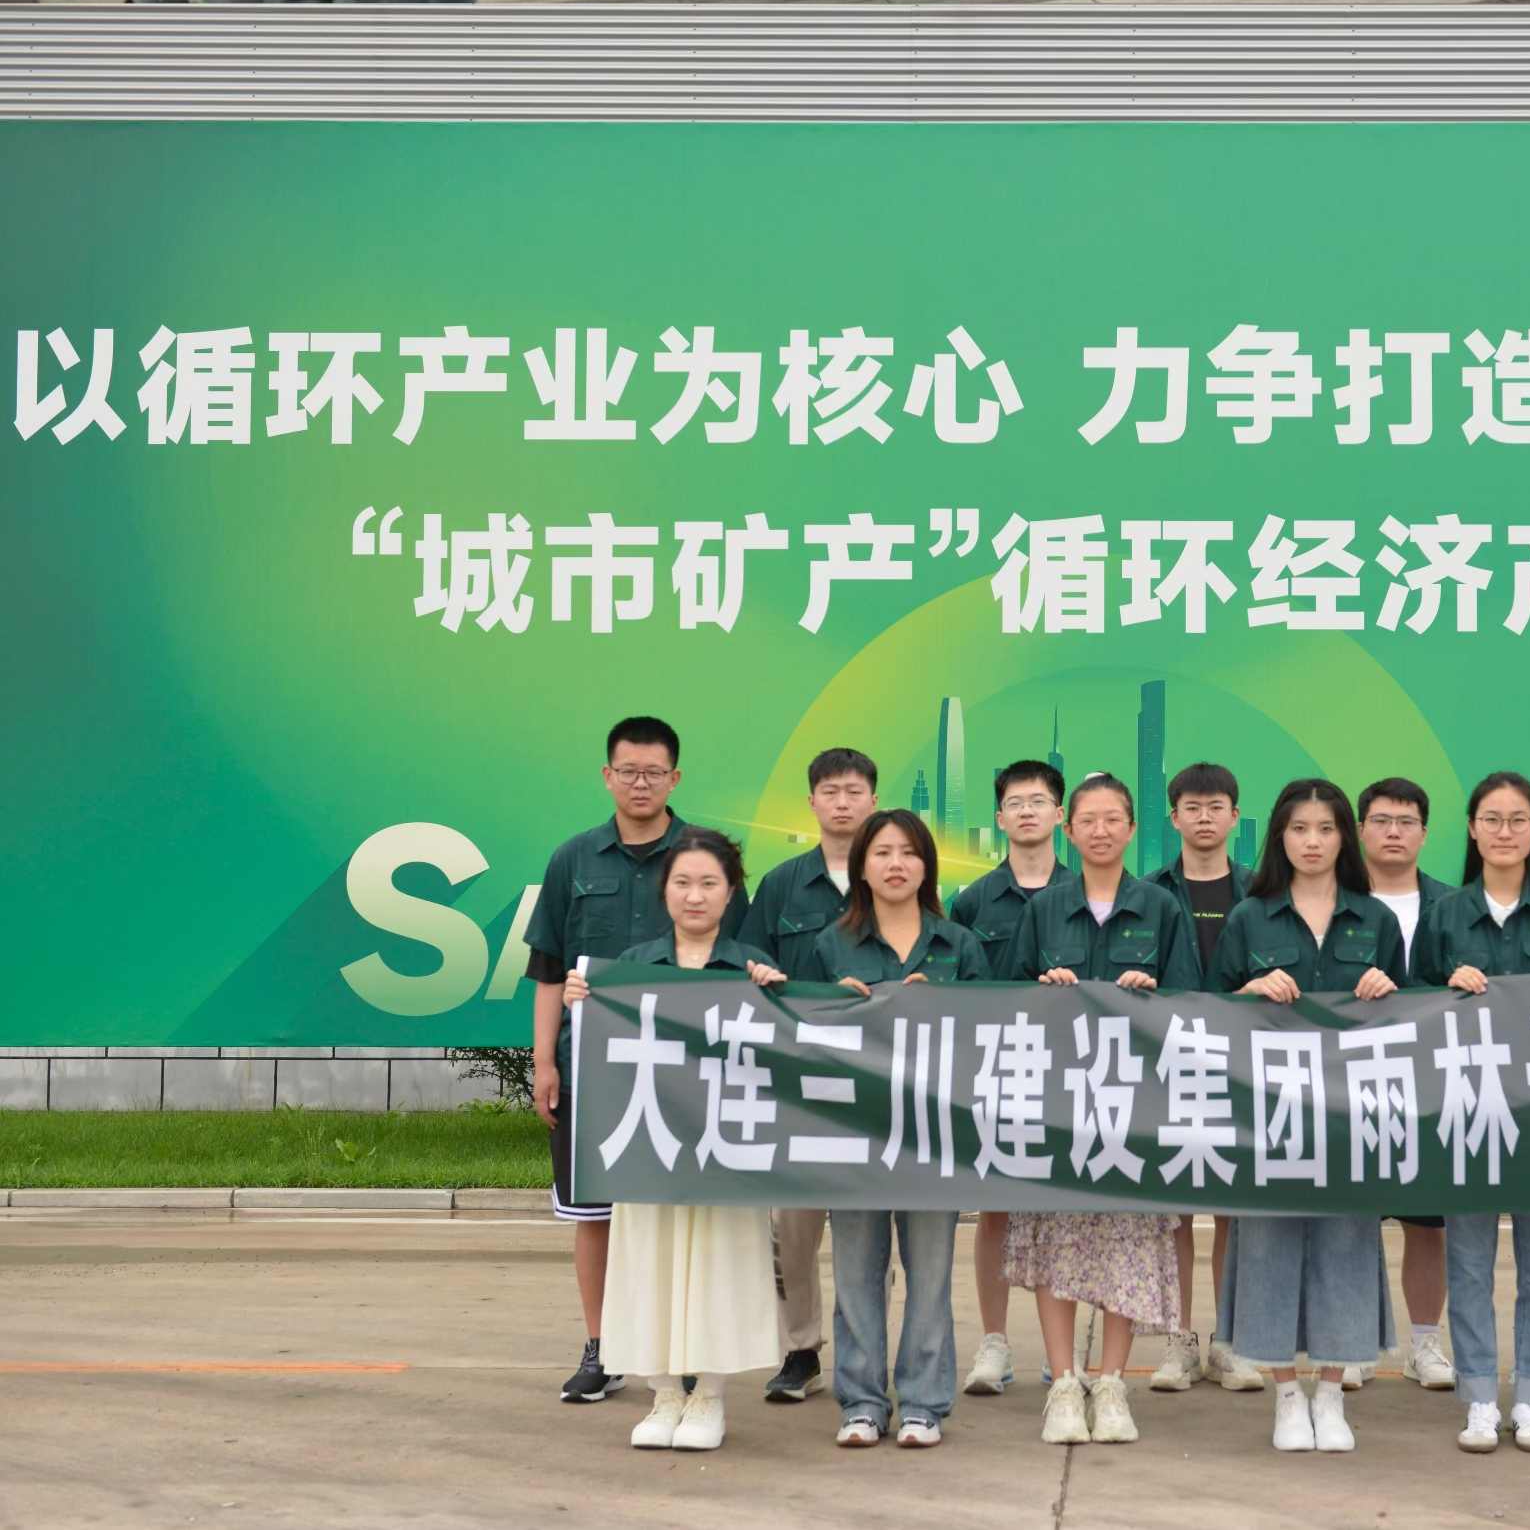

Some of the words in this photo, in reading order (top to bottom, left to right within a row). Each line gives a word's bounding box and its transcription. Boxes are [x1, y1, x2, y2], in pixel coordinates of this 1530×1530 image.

[13, 324, 1023, 446] 以循环产业为核心
